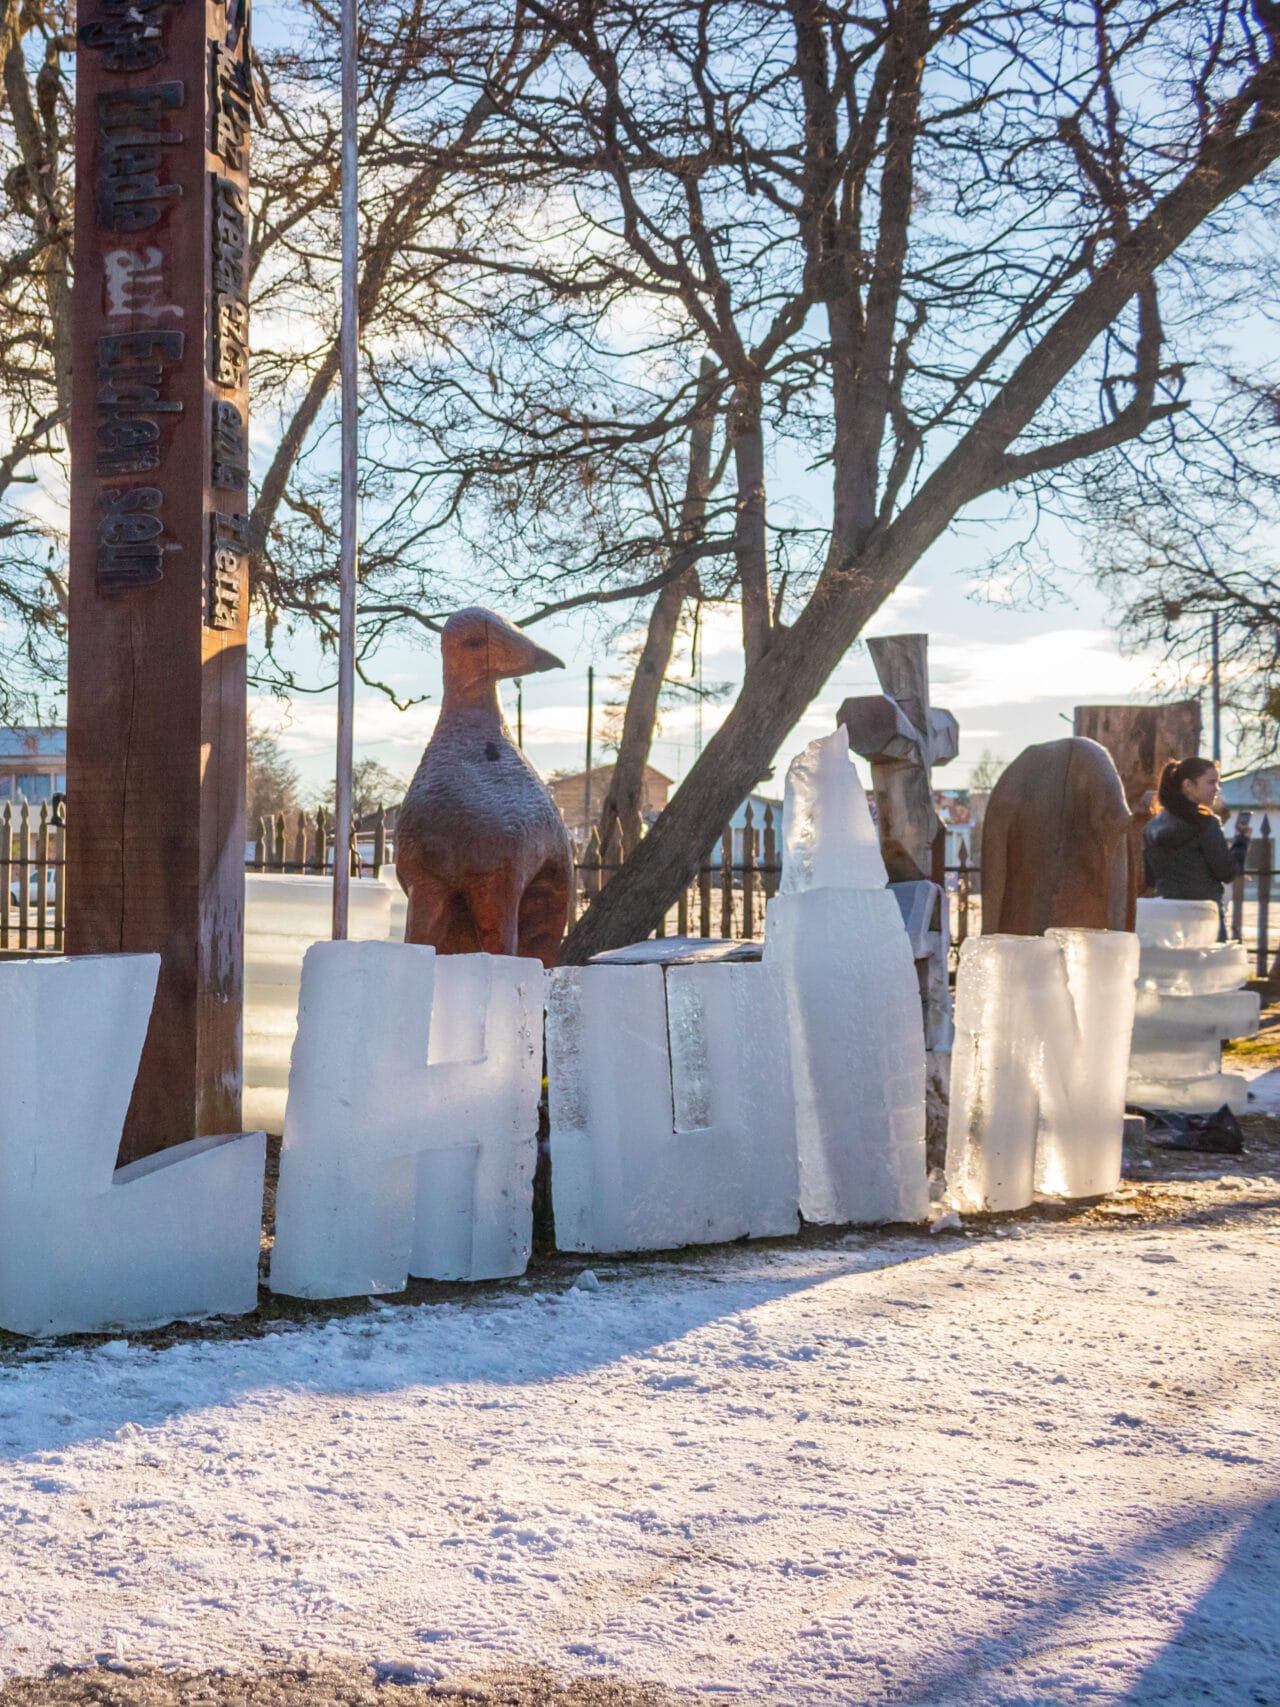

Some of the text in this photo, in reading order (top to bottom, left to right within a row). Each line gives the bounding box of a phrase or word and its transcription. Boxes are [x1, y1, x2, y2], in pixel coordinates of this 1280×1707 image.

[104, 246, 184, 317] auf
[95, 330, 184, 475] Erden
[97, 486, 183, 587] sein
[212, 511, 249, 631] Tierra
